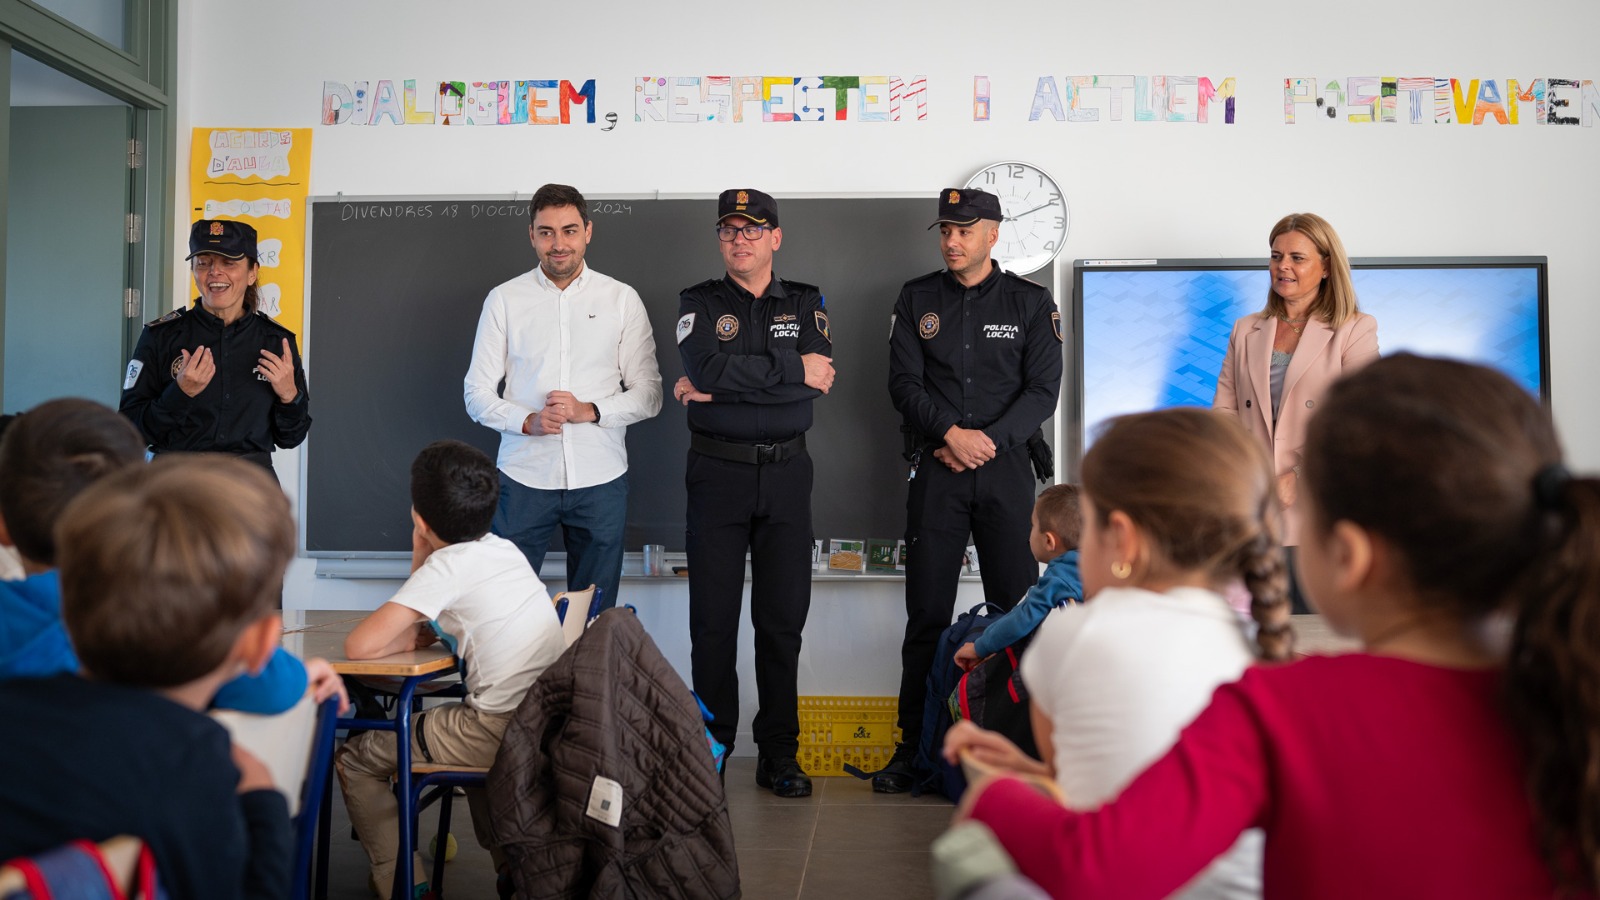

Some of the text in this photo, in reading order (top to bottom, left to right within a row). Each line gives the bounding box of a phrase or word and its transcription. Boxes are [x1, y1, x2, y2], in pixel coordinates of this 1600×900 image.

[634, 75, 928, 123] RESPECTEM
[973, 75, 991, 122] I
[1028, 75, 1237, 124] ACTUEM
[214, 131, 291, 149] ACORDS
[985, 171, 996, 185] 11
[1007, 165, 1025, 179] 12
[1038, 174, 1043, 188] 1
[1048, 192, 1061, 206] 2
[341, 203, 433, 221] DIVENDRES
[441, 204, 459, 218] 18
[592, 201, 632, 215] 2024
[1053, 216, 1065, 230] 3
[983, 324, 1019, 333] POLICIA
[986, 331, 1015, 340] LOCAL
